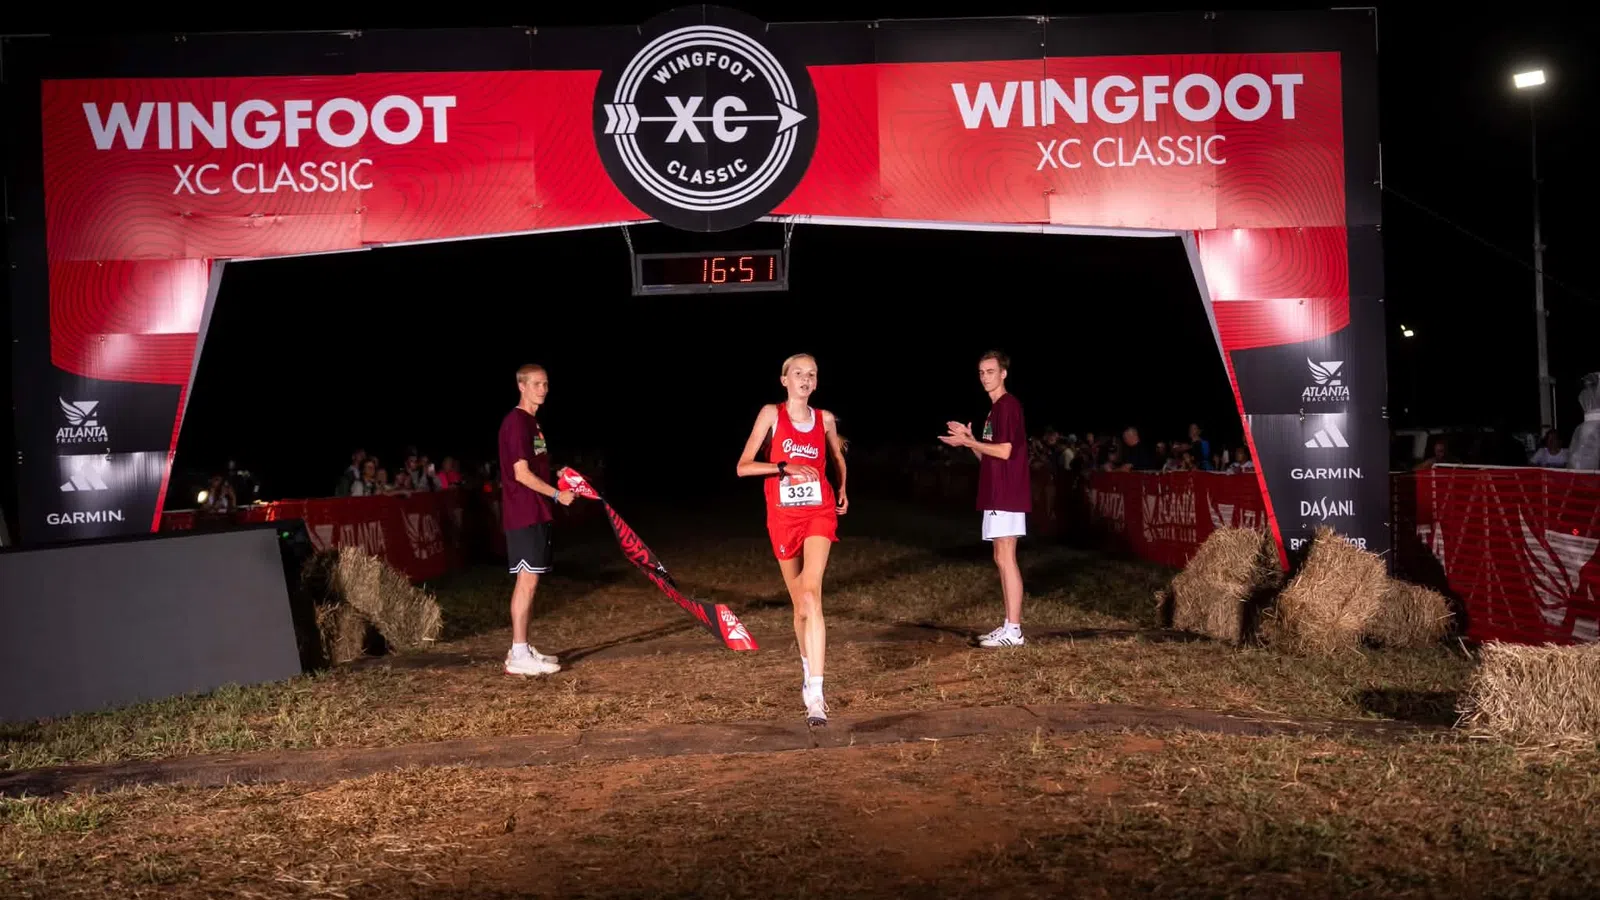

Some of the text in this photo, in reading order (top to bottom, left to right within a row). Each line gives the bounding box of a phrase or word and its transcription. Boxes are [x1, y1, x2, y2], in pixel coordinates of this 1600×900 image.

[652, 52, 755, 85] WINGFOOT
[951, 73, 1304, 129] WINGFOOT
[83, 95, 457, 150] WINGFOOT
[664, 95, 748, 143] XC
[1036, 134, 1227, 170] XC CLASSIC
[173, 158, 374, 195] XC CLASSIC
[667, 158, 748, 184] CLASSIC
[1302, 386, 1350, 397] ATLANTA
[56, 426, 108, 438] ATLANTA
[1291, 468, 1361, 479] GARMIN
[788, 486, 814, 498] 332
[46, 509, 122, 525] GARMIN
[1301, 496, 1354, 521] DASANI
